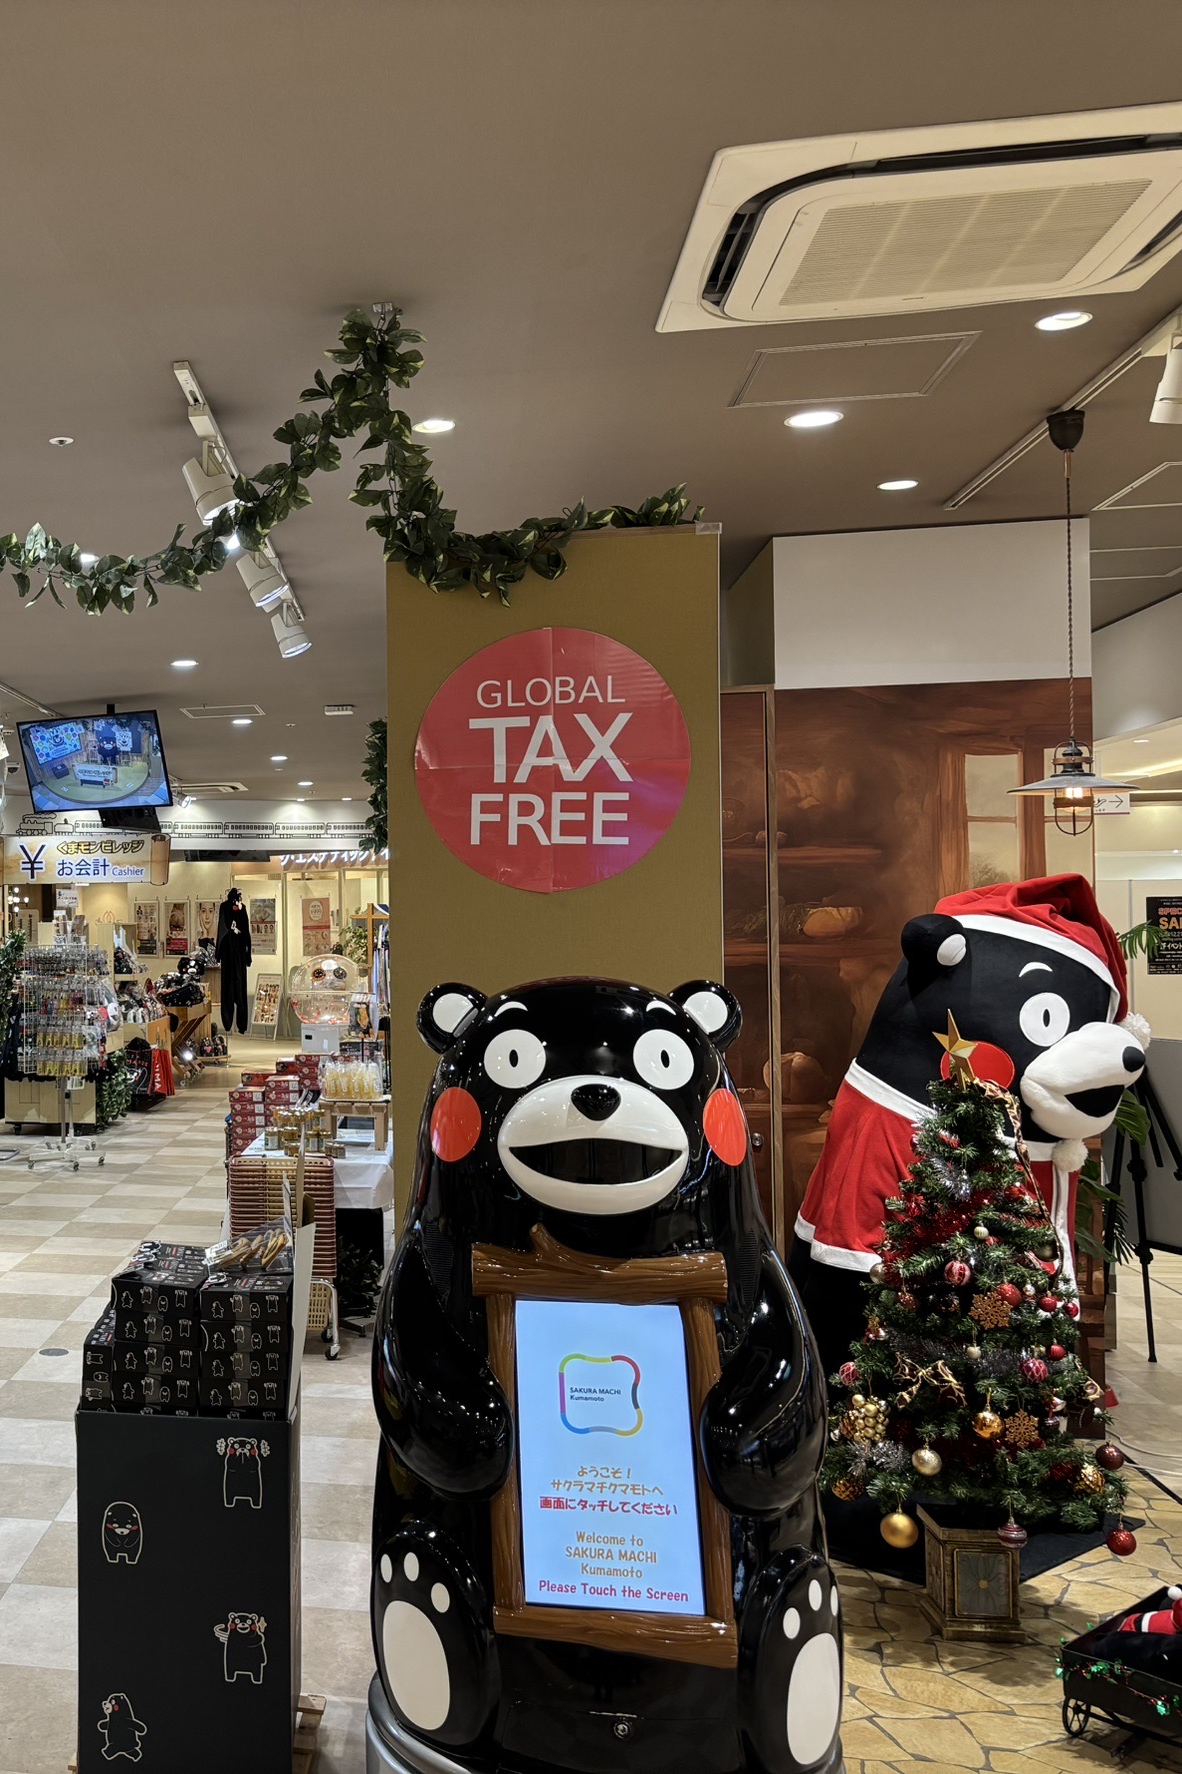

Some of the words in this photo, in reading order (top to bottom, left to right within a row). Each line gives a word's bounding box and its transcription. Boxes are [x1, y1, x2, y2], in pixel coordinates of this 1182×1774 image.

[476, 675, 626, 709] GLOBAL
[468, 712, 634, 784] TAX
[469, 791, 630, 846] FREE
[56, 840, 145, 855] くまモンビレッジ
[57, 858, 110, 877] お会計
[112, 867, 145, 876] Cashier
[570, 1387, 597, 1395] SAKURA
[598, 1388, 622, 1396] MACHI
[551, 1479, 664, 1496] サクラマチクマモトへ
[540, 1497, 678, 1516] 画面にタッチしてください
[576, 1531, 626, 1546] Welcome
[629, 1534, 644, 1547] to
[565, 1546, 614, 1561] SAKURA
[618, 1549, 657, 1564] MACHI
[581, 1563, 643, 1579] Kumamoto
[539, 1580, 577, 1594] Please
[581, 1583, 617, 1597] Touch
[621, 1586, 642, 1599] the
[646, 1587, 689, 1602] Screen
